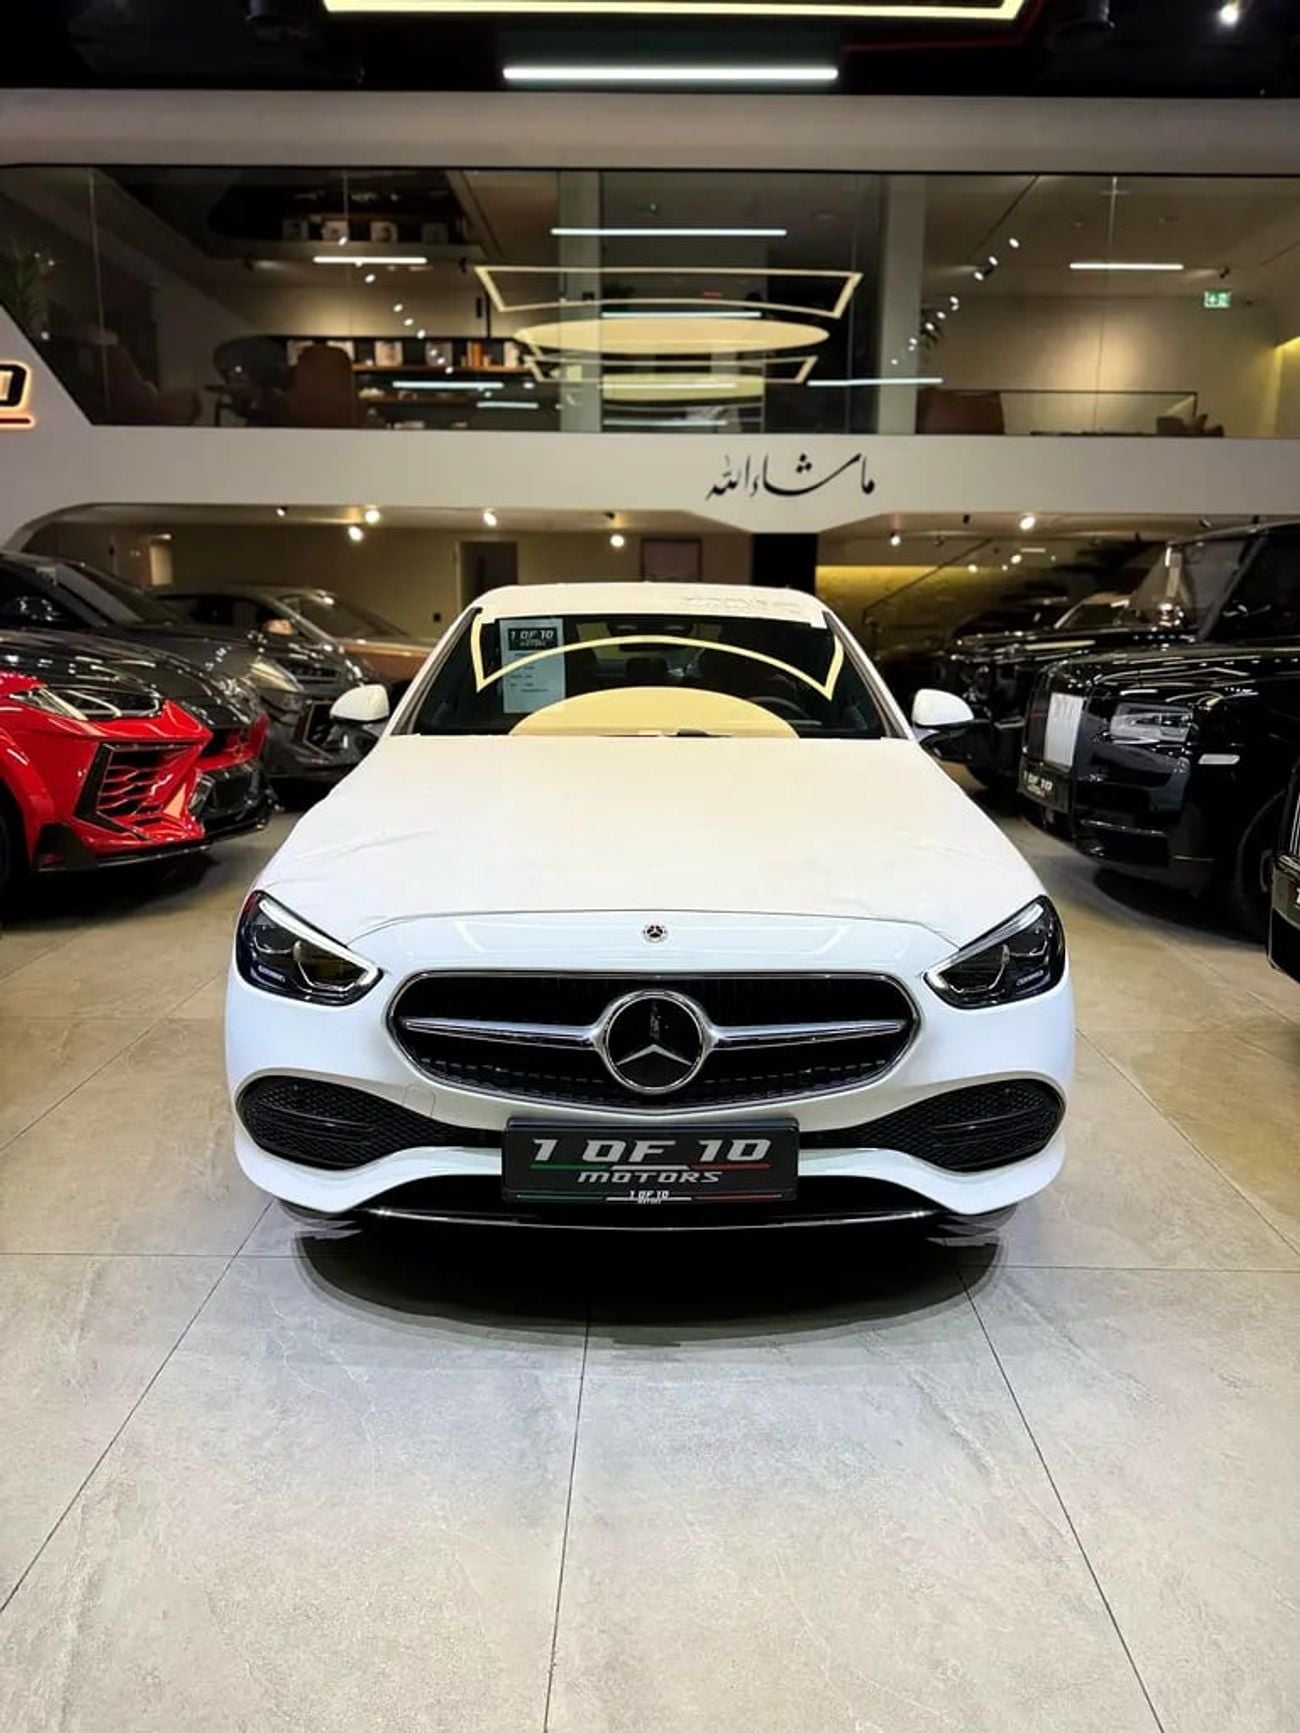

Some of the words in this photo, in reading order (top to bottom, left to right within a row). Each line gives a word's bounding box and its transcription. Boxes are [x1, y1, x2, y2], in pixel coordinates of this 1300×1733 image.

[540, 630, 554, 640] 10
[533, 1139, 557, 1162] 1
[582, 1139, 676, 1162] OF
[699, 1139, 771, 1162] 10
[577, 1171, 723, 1183] MOTORS
[656, 1190, 669, 1199] 10
